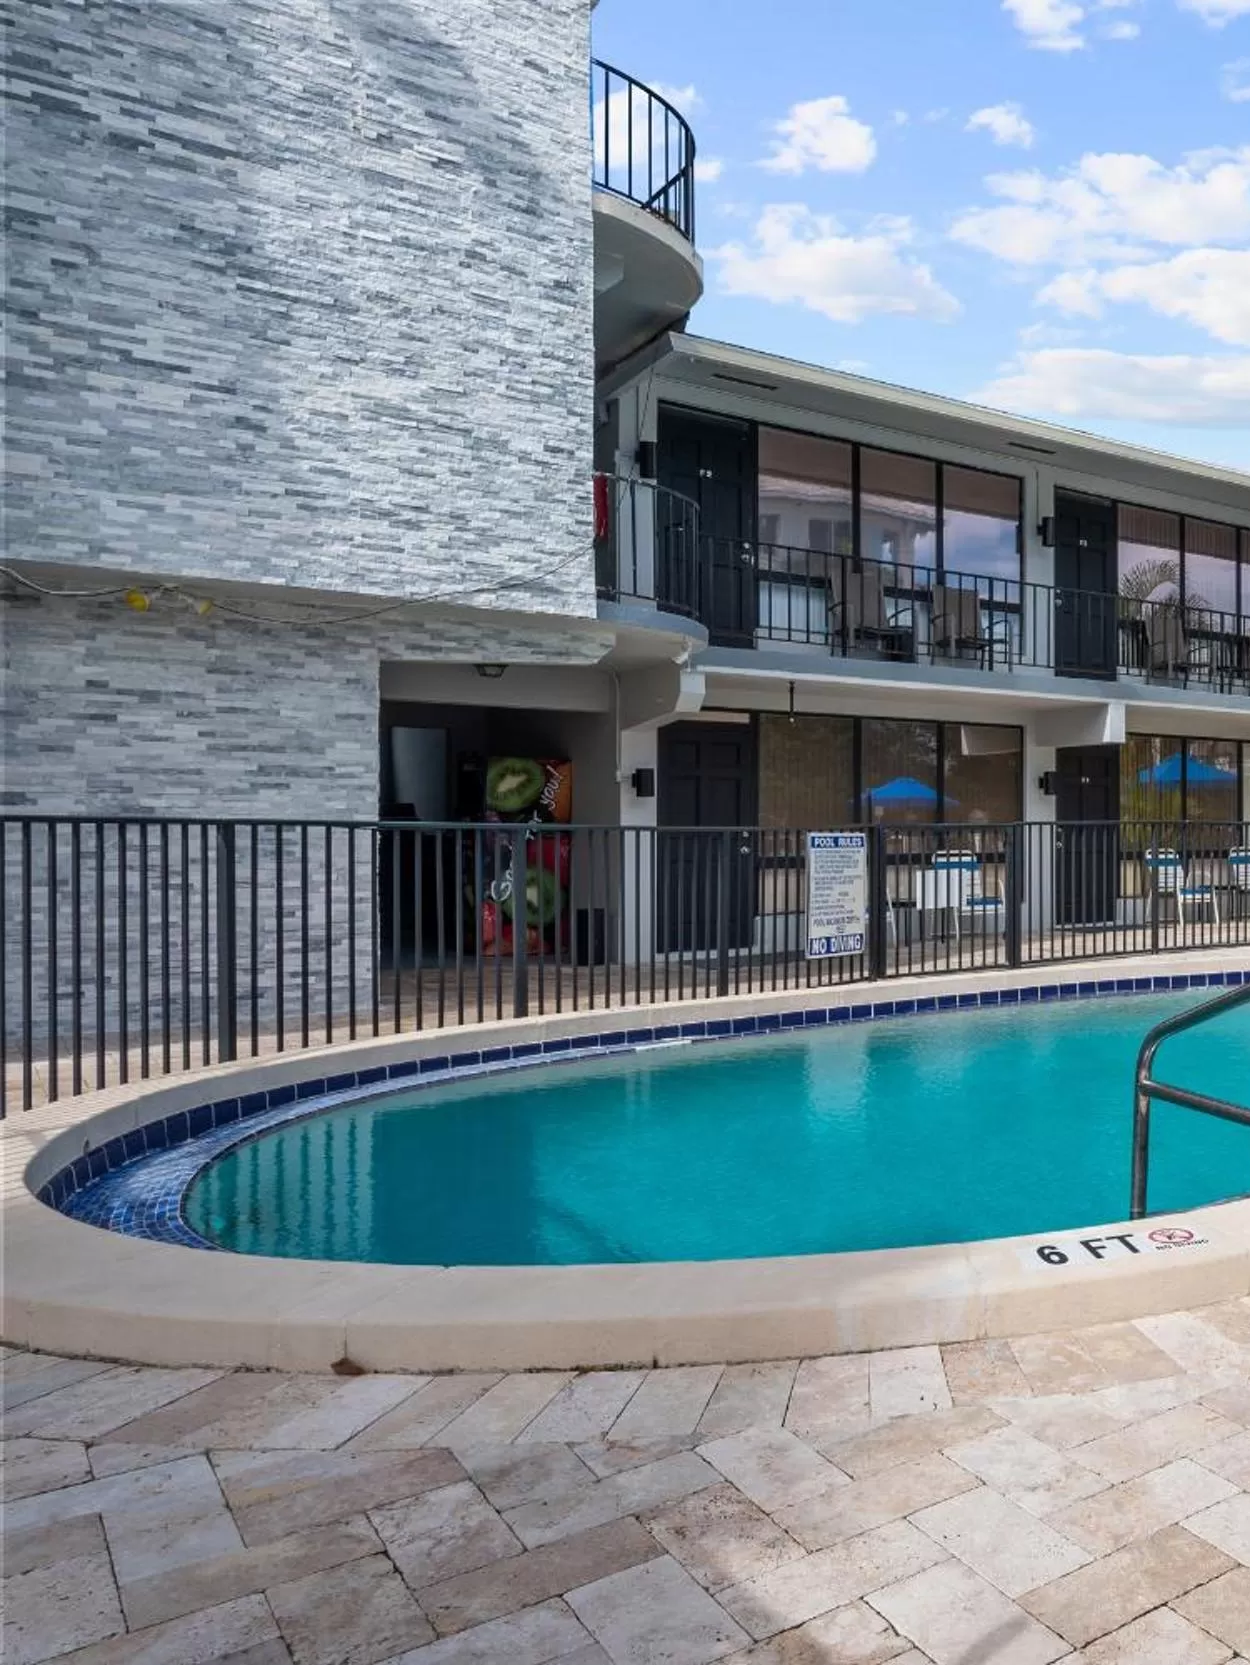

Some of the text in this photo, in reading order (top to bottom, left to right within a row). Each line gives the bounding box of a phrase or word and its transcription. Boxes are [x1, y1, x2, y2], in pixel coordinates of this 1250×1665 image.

[540, 764, 562, 811] you!
[814, 837, 863, 848] POOL RULES
[811, 934, 862, 954] NO DIVING
[1036, 1245, 1069, 1265] 6
[1079, 1233, 1140, 1259] FT
